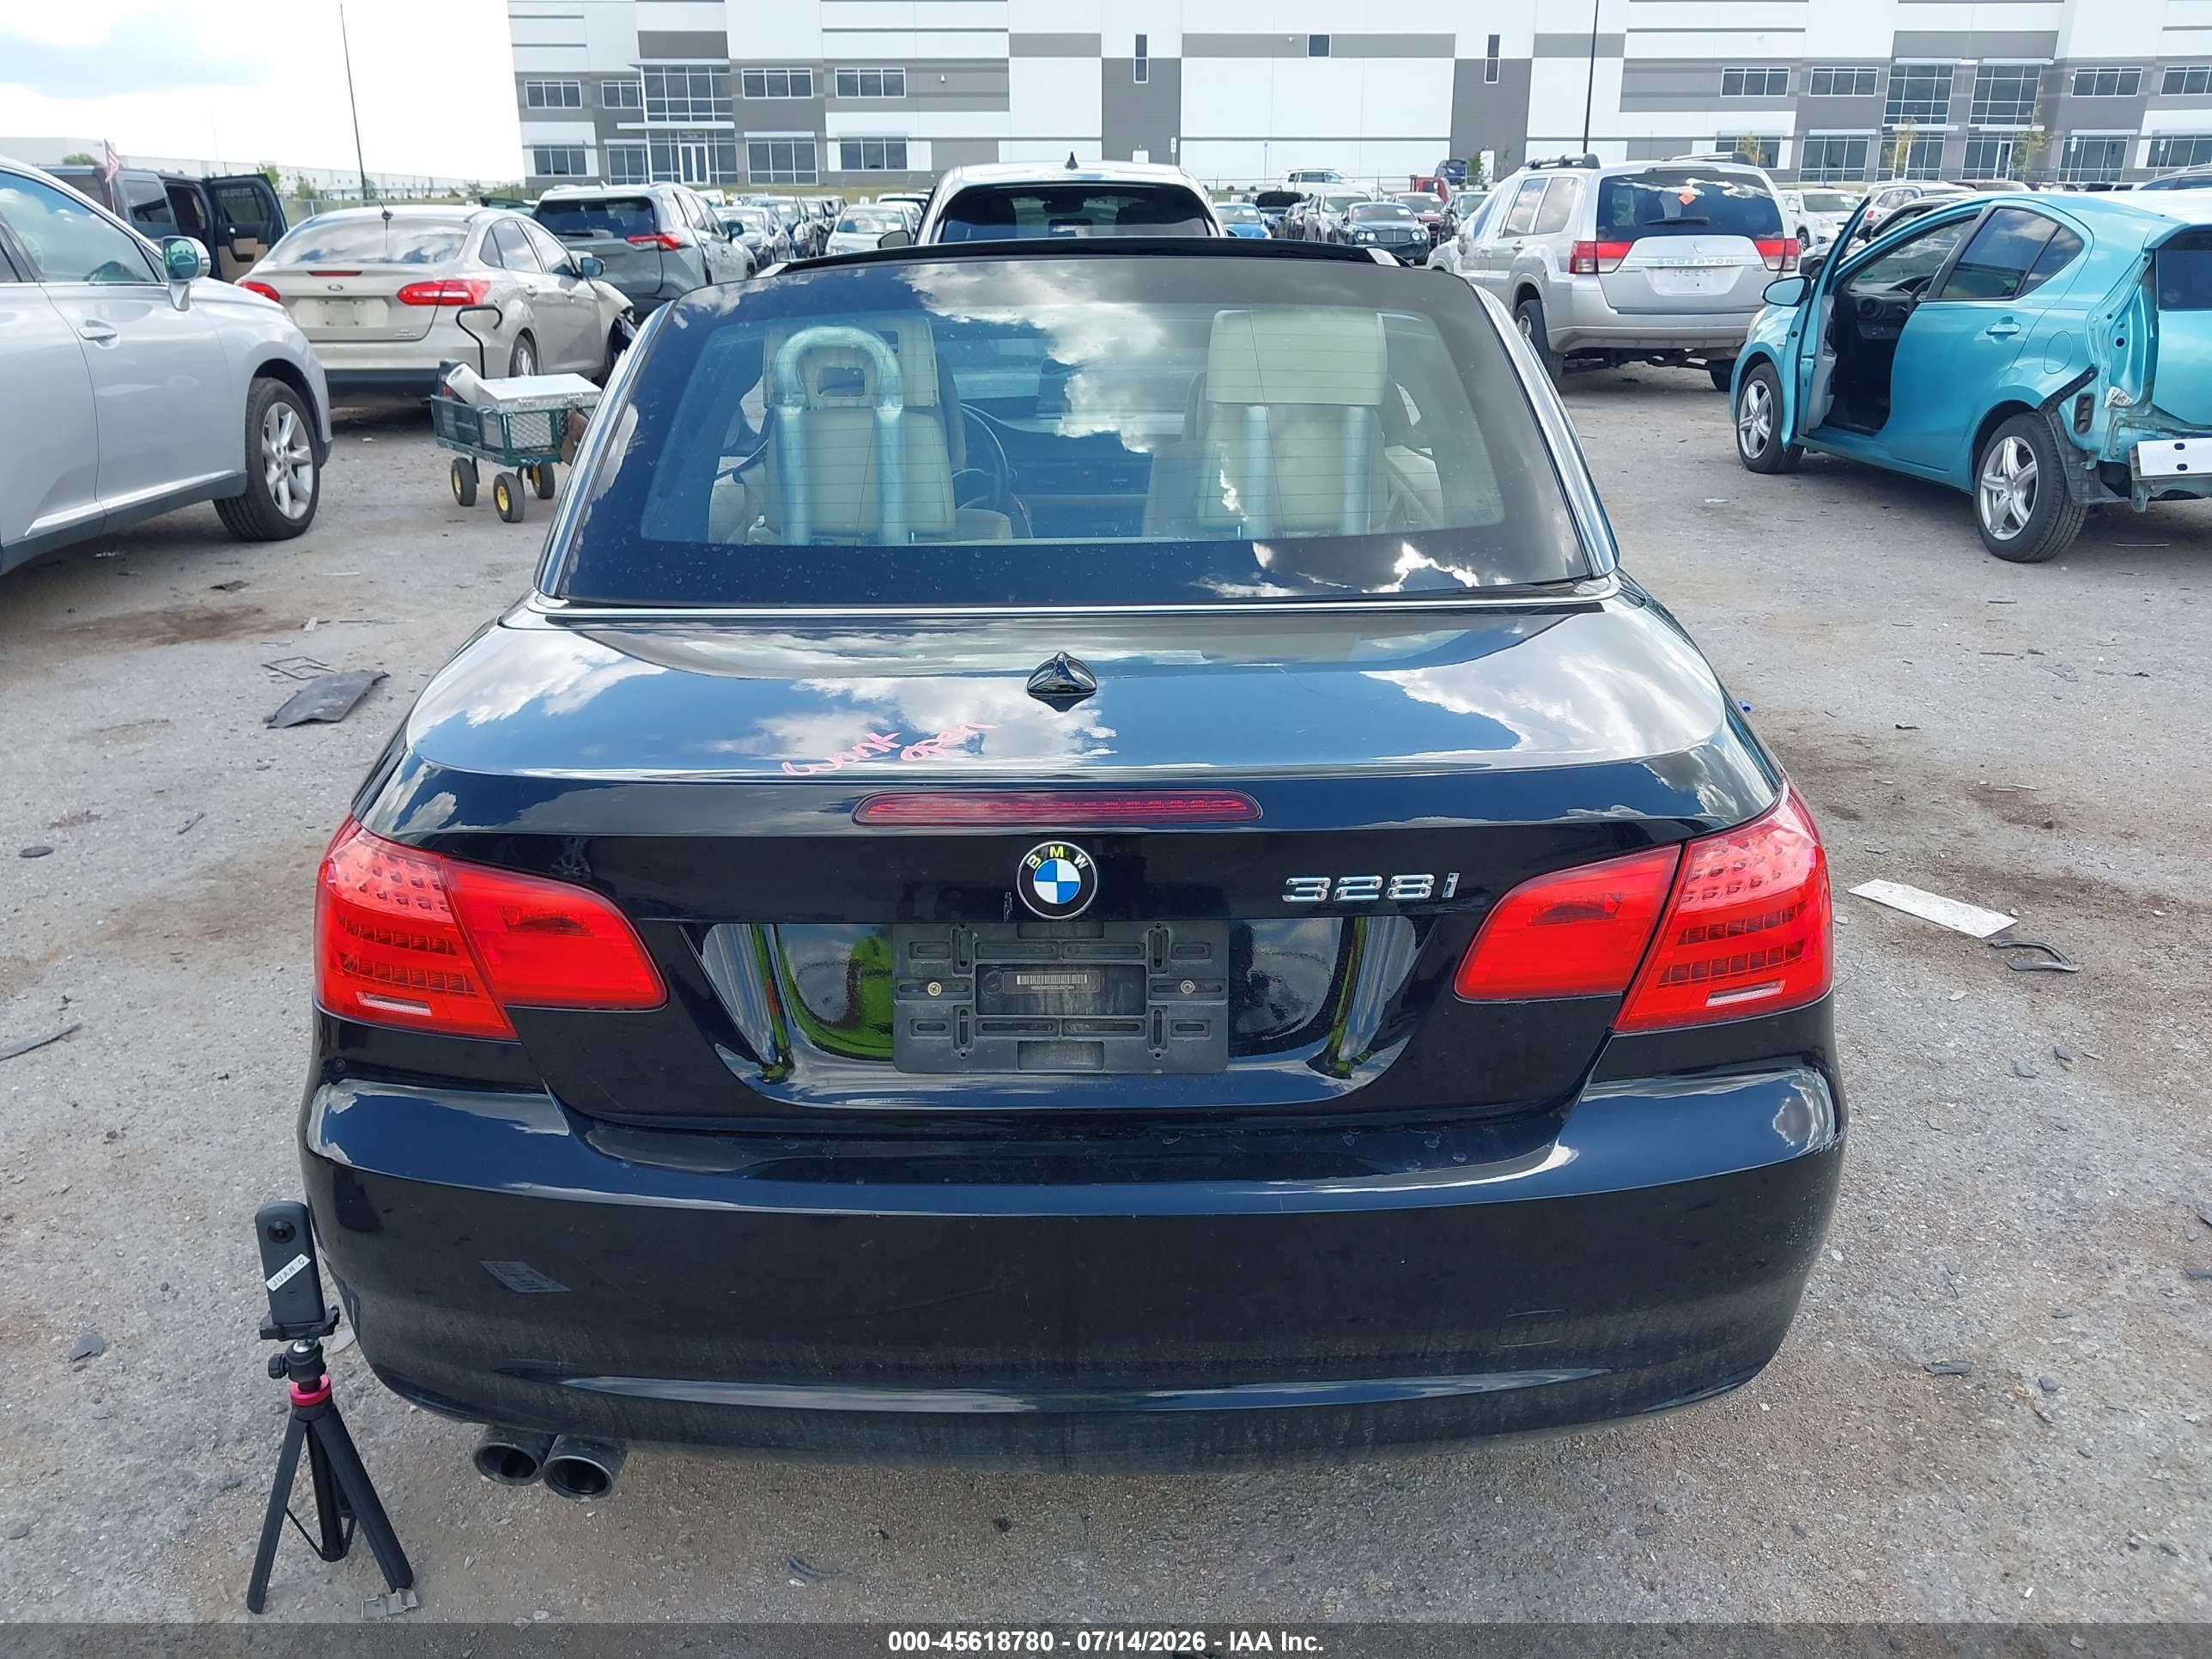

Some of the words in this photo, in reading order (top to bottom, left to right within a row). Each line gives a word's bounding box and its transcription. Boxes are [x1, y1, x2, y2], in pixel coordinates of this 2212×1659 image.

[1026, 845, 1090, 870] BMW
[1282, 872, 1461, 902] 328i
[272, 1265, 297, 1287] JUAN
